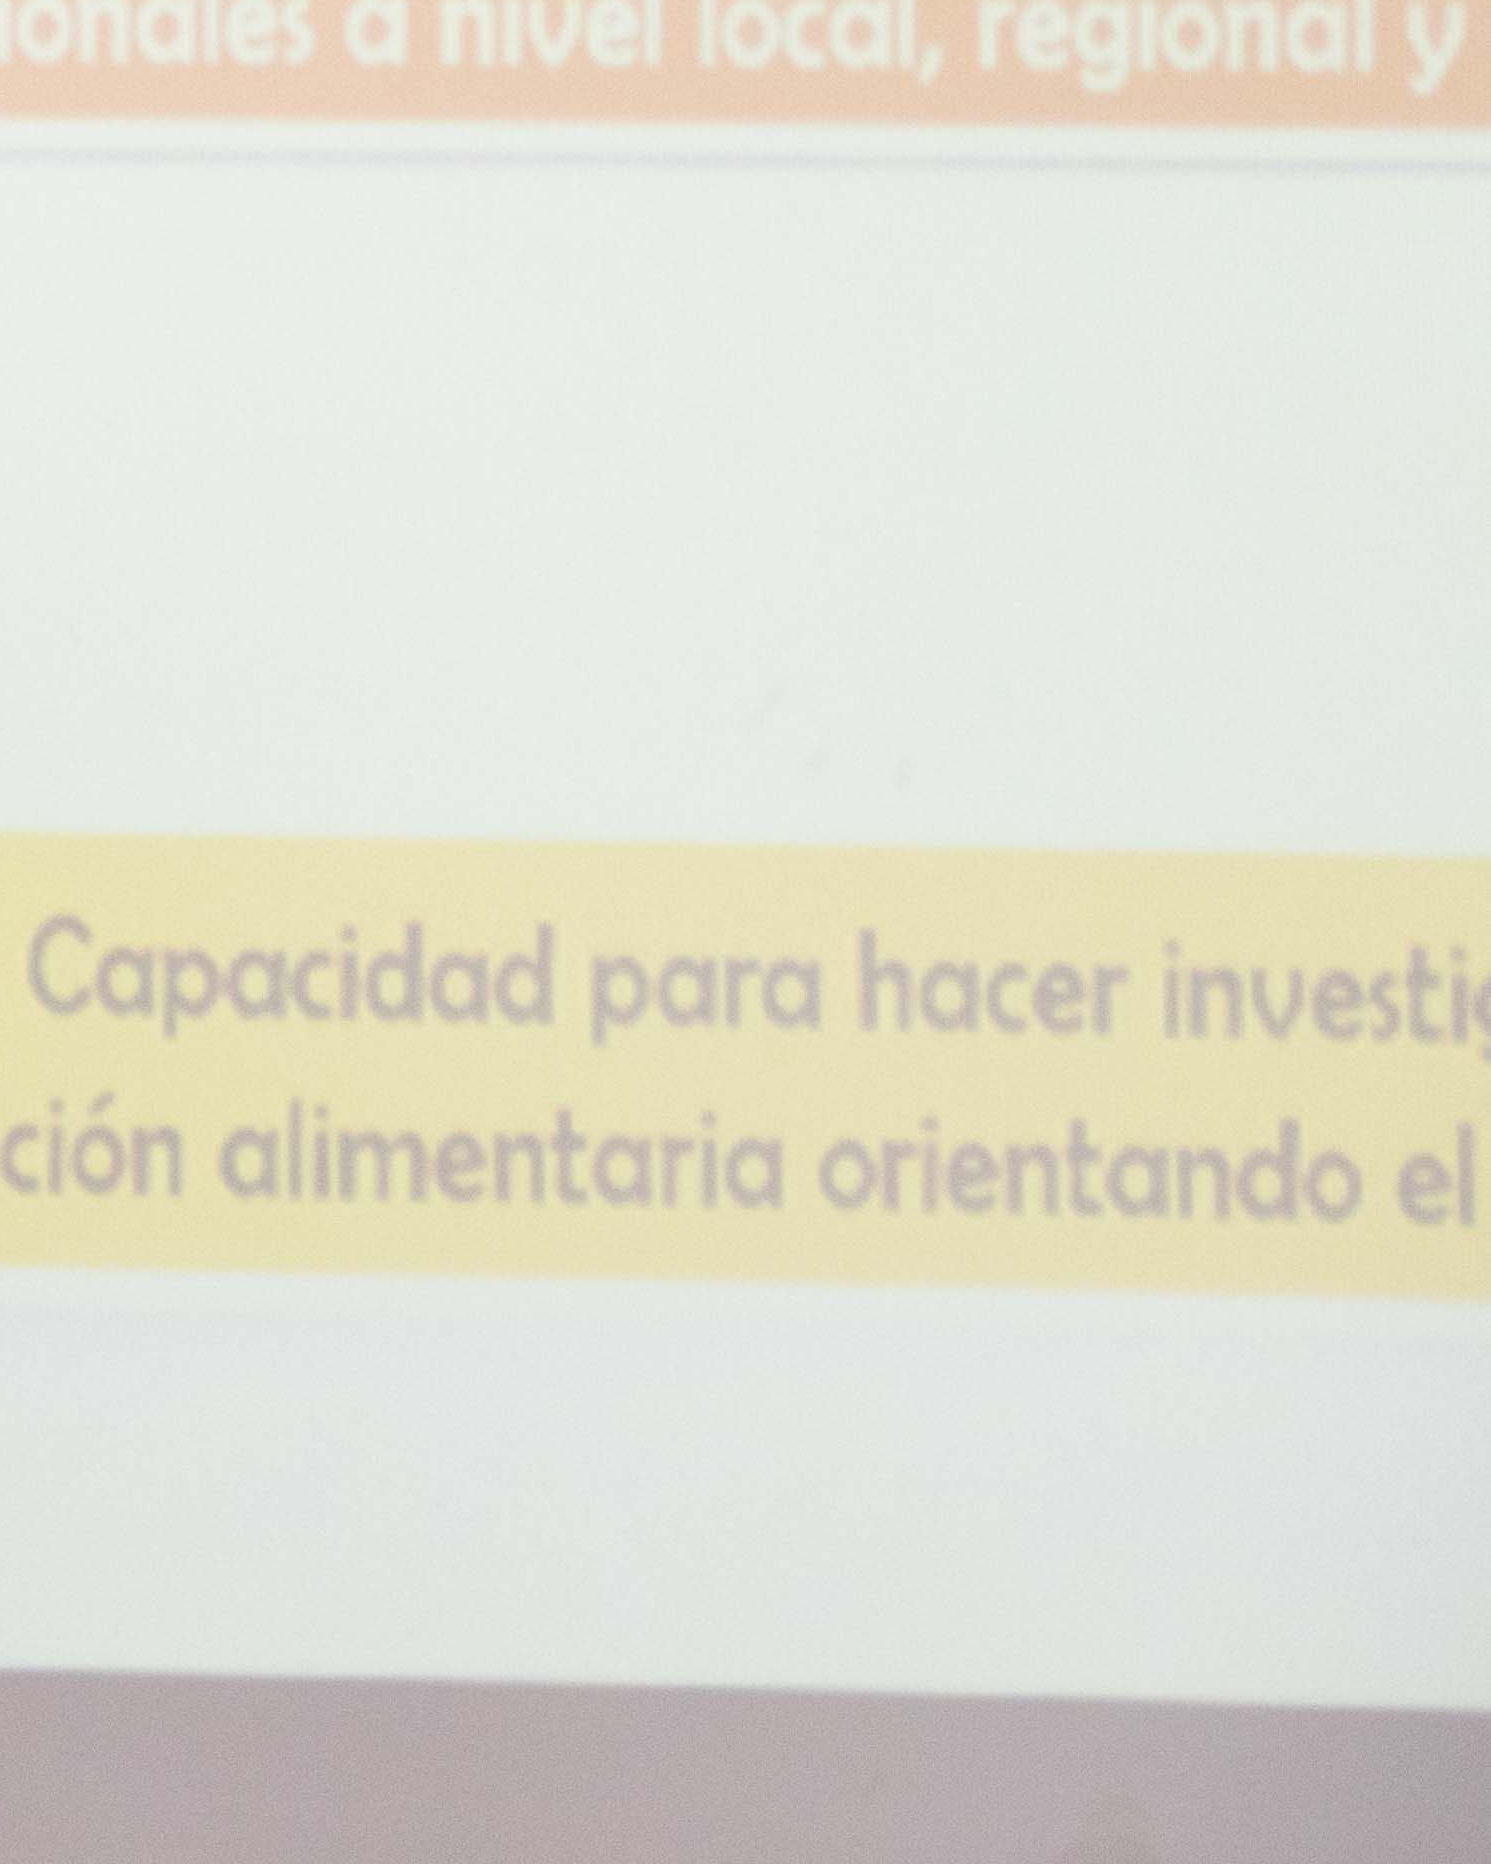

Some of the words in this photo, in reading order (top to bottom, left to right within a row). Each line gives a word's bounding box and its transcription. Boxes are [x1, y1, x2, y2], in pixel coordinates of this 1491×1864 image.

[1404, 0, 1468, 96] y
[26, 913, 556, 1039] Capacidad
[589, 954, 823, 1047] para
[857, 928, 1130, 1038] hacer
[216, 1100, 785, 1212] alimentaria
[817, 1116, 1365, 1225] orientando
[1394, 1120, 1479, 1229] el
